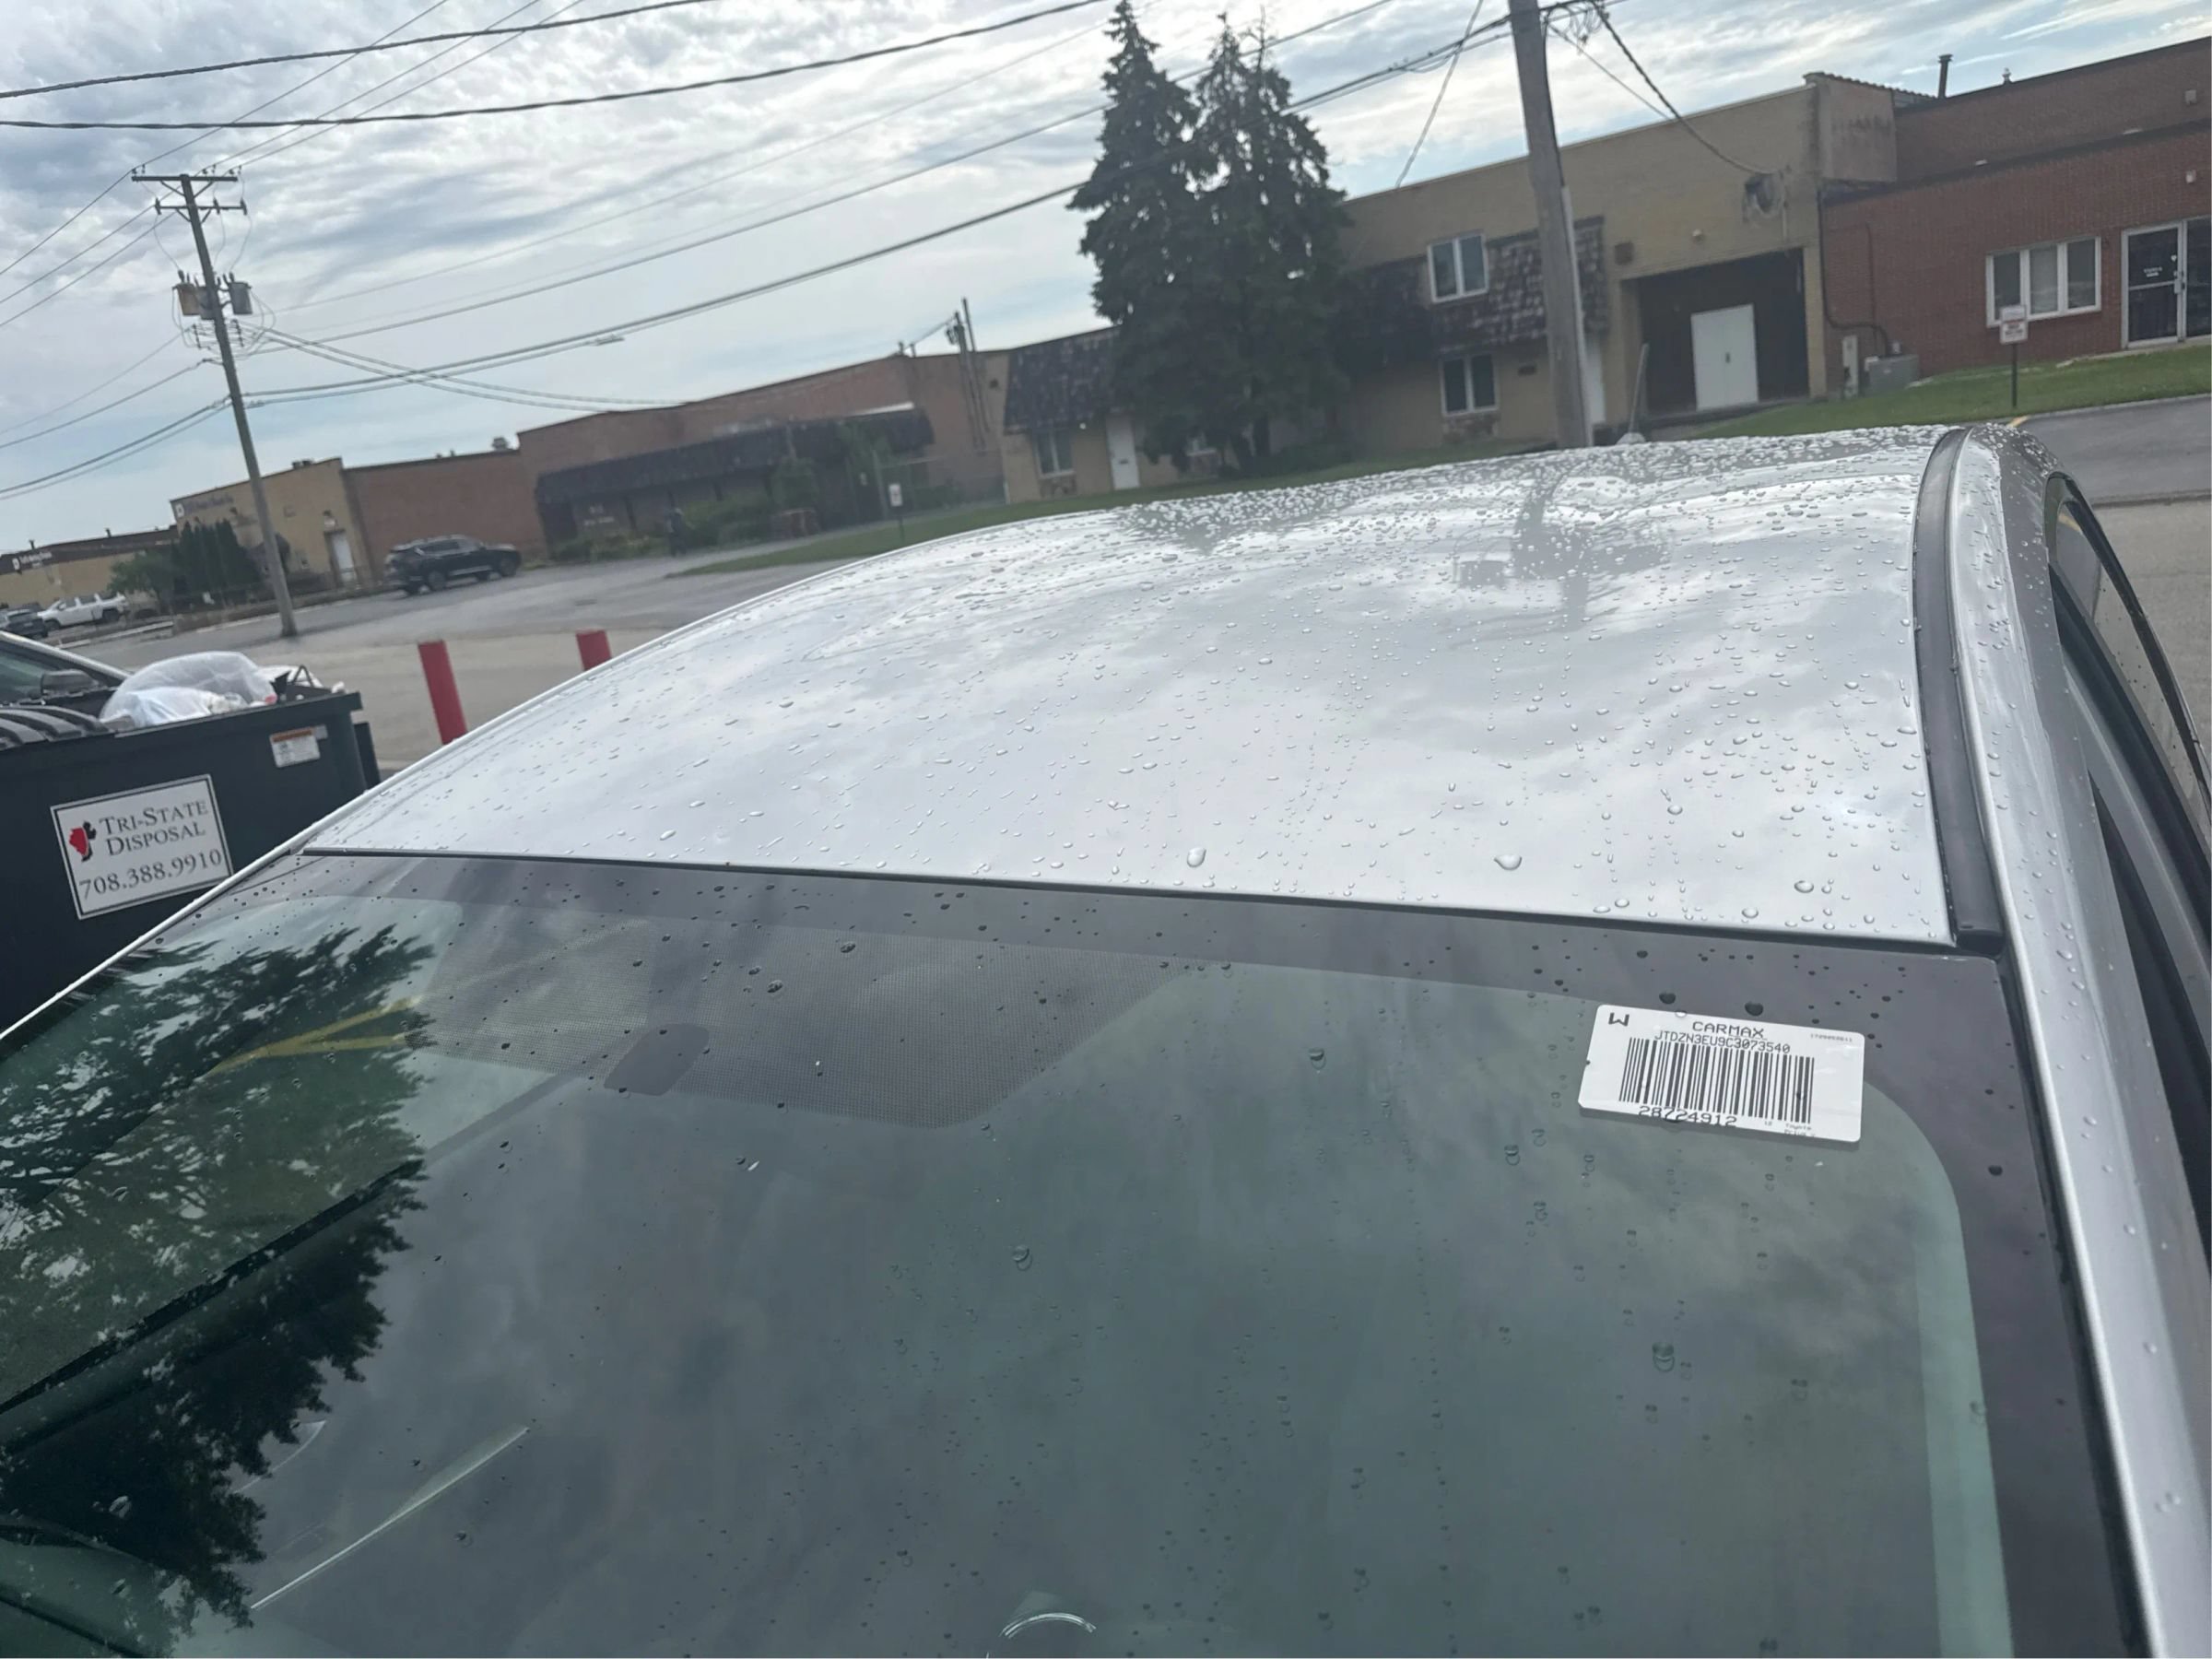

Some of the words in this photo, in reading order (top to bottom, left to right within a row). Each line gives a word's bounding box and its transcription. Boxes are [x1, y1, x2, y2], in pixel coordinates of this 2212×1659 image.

[100, 800, 208, 835] TRI-STATE
[106, 821, 206, 856] DISPOSAL
[79, 849, 222, 900] 708.388.9910
[1608, 1012, 1630, 1027] W
[1692, 1021, 1764, 1038] CARMAX
[1654, 1030, 1790, 1053] JTDZN3EU9C3073540
[1639, 1105, 1737, 1127] 28724912
